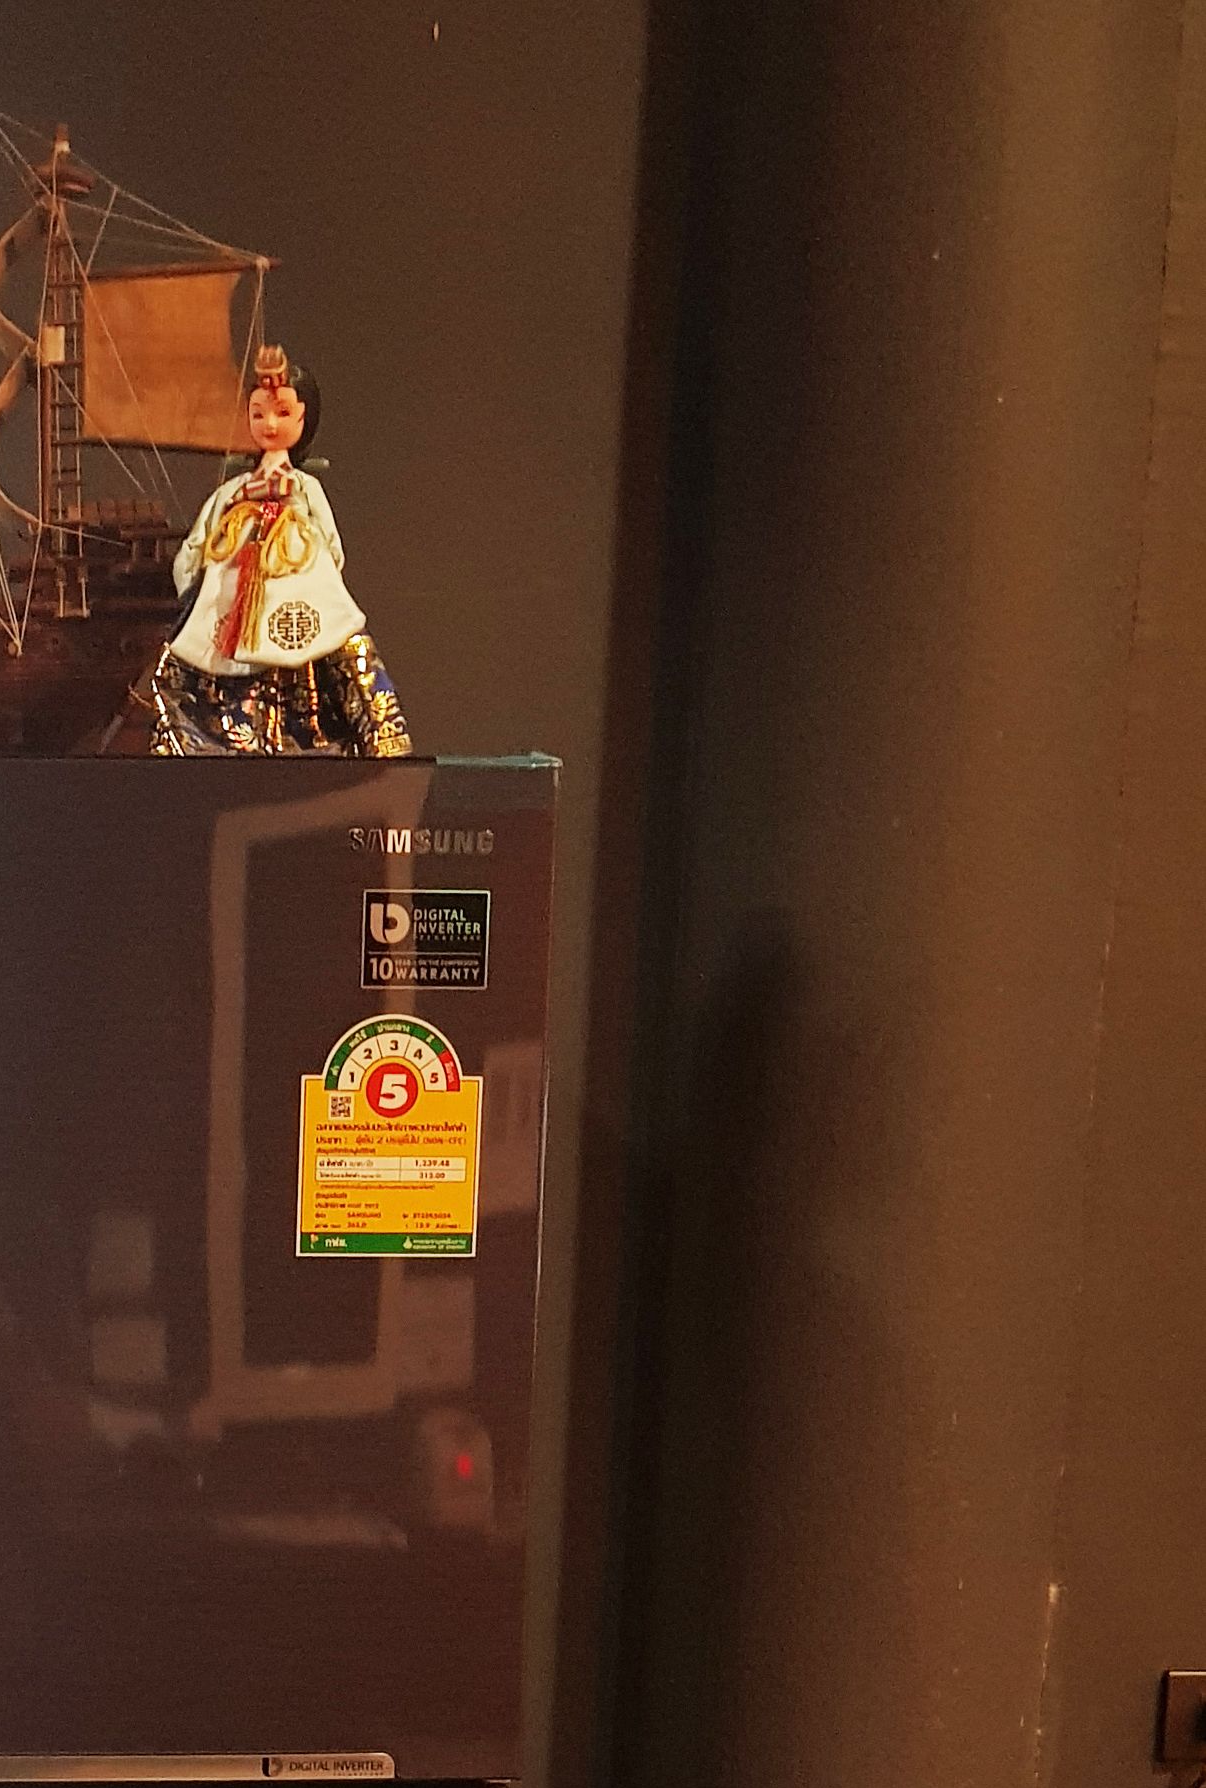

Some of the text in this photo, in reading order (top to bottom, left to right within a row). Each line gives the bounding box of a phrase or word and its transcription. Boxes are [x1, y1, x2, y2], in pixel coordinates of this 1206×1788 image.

[349, 828, 495, 854] SAMSUNG
[413, 908, 467, 922] DIGITAL
[413, 921, 481, 935] INVERTER
[369, 957, 393, 980] 10
[395, 966, 481, 981] WARRANTY
[349, 1072, 355, 1083] 1
[363, 1049, 373, 1060] 2
[389, 1040, 399, 1051] 3
[413, 1048, 423, 1060] 4
[429, 1072, 439, 1083] 5
[378, 1073, 408, 1109] 5
[289, 1760, 384, 1771] DIGITAL INVERTER
